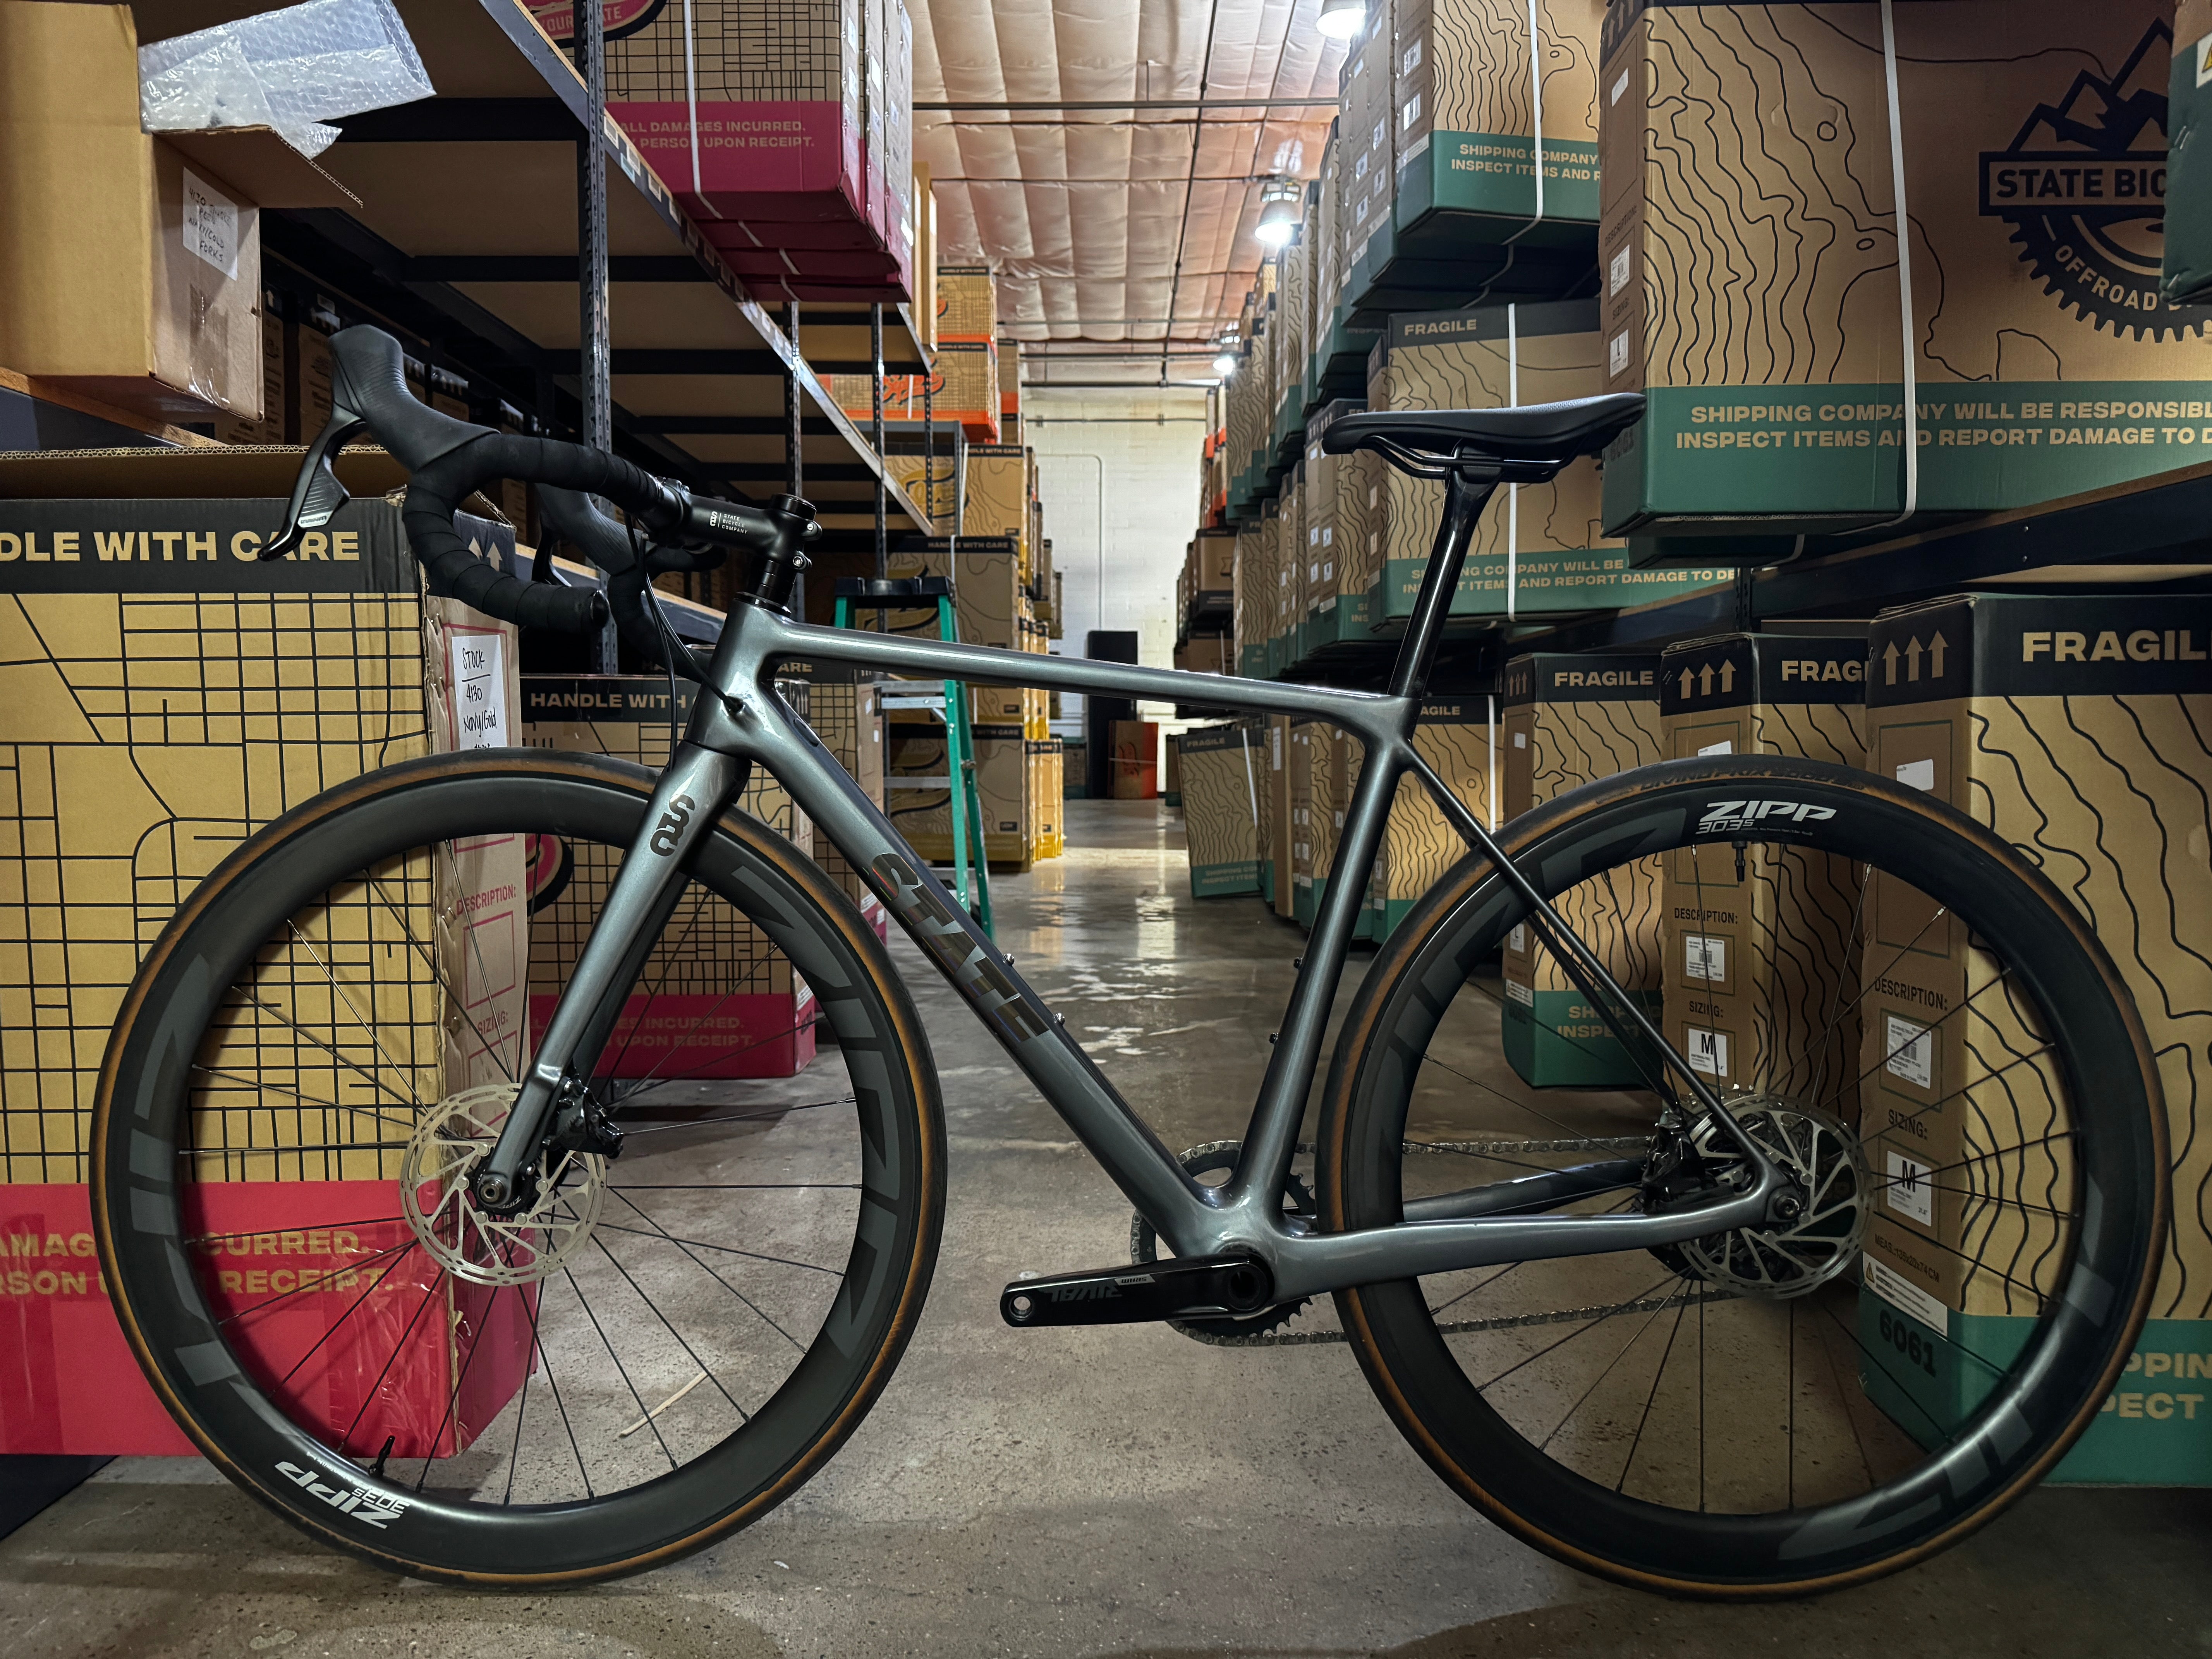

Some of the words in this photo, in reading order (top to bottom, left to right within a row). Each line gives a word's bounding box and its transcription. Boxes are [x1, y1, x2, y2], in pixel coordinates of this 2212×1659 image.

[727, 121, 805, 131] INCURRED.
[704, 137, 744, 148] UPON
[749, 136, 814, 147] RECEIPT.
[1460, 144, 1526, 158] SHIPPING
[1451, 159, 1512, 173] INSPECT
[1561, 168, 1590, 180] AND
[1996, 169, 2103, 198] STATE
[2055, 244, 2157, 311] OFFROAD
[1404, 319, 1477, 336] FRAGILE
[1691, 405, 1812, 422] SHIPPING
[1819, 404, 1946, 422] COMPANY
[1954, 403, 2014, 419] WILL
[2021, 402, 2054, 419] BE
[1676, 431, 1786, 448] INSPECT
[1794, 430, 1870, 447] ITEMS
[1939, 429, 2042, 446] REPORT
[2049, 428, 2155, 445] DAMAGE
[2162, 427, 2195, 444] TO
[722, 519, 744, 527] BICYCLE
[722, 524, 747, 534] COMPANY
[93, 531, 217, 561] WITH
[1563, 560, 1600, 572] WILL
[1604, 559, 1623, 570] BE
[1519, 577, 1551, 588] AND
[1555, 574, 1617, 586] REPORT
[1622, 571, 1687, 584] DAMAGE
[1691, 570, 1712, 580] TO
[462, 647, 485, 670] STOCK
[1554, 670, 1654, 687] FRAGILE
[466, 684, 482, 703] 4130
[531, 692, 622, 708] HANDLE
[1187, 737, 1225, 747] FRAGILE
[1699, 800, 1837, 823] ZIPP
[456, 883, 517, 915] DESCRIPTION:
[864, 853, 1049, 1042] STATE
[1874, 977, 1948, 1011] DESCRIPTION:
[1701, 1033, 1713, 1055] M
[1889, 1109, 1927, 1140] SIZING:
[1902, 1159, 1916, 1193] M
[220, 1268, 394, 1294] RECEIPT.
[1040, 1284, 1123, 1302] RIVAL
[1880, 1309, 1936, 1378] 6061
[275, 1461, 401, 1530] ZIPP
